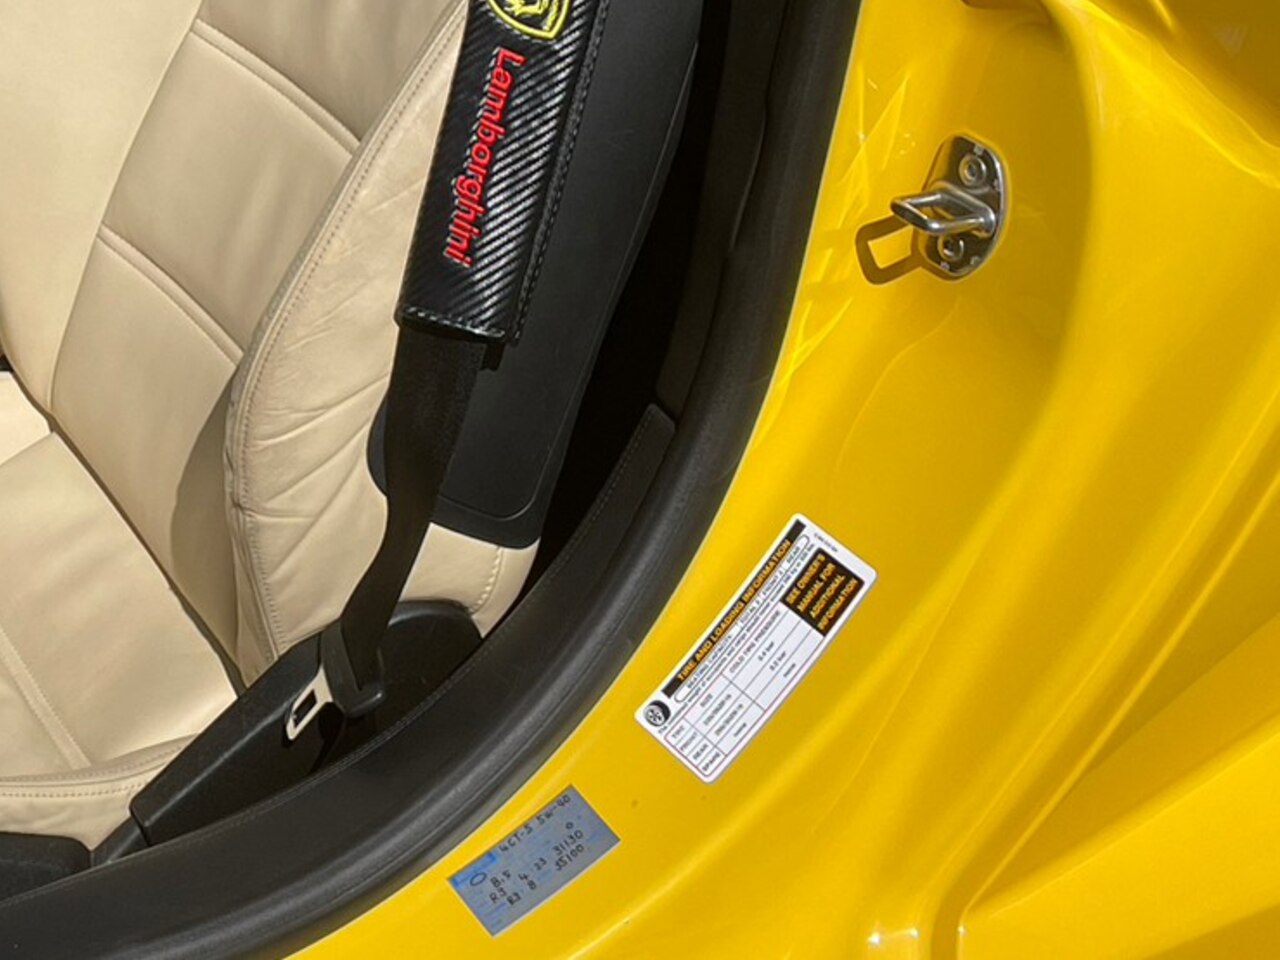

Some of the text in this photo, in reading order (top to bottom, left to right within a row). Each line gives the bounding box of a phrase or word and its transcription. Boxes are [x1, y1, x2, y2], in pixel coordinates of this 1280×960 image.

[445, 47, 525, 266] Lamborghini
[785, 587, 799, 603] SEE
[797, 553, 825, 589] OWNER'S
[796, 579, 823, 611] MANUAL
[820, 562, 836, 580] FOR
[808, 573, 844, 617] ADDITIONAL
[677, 660, 696, 680] TIRE
[694, 640, 712, 660] AND
[710, 601, 744, 640] LOADING
[742, 539, 791, 601] INFORMATION
[817, 578, 857, 629] INFORMATION
